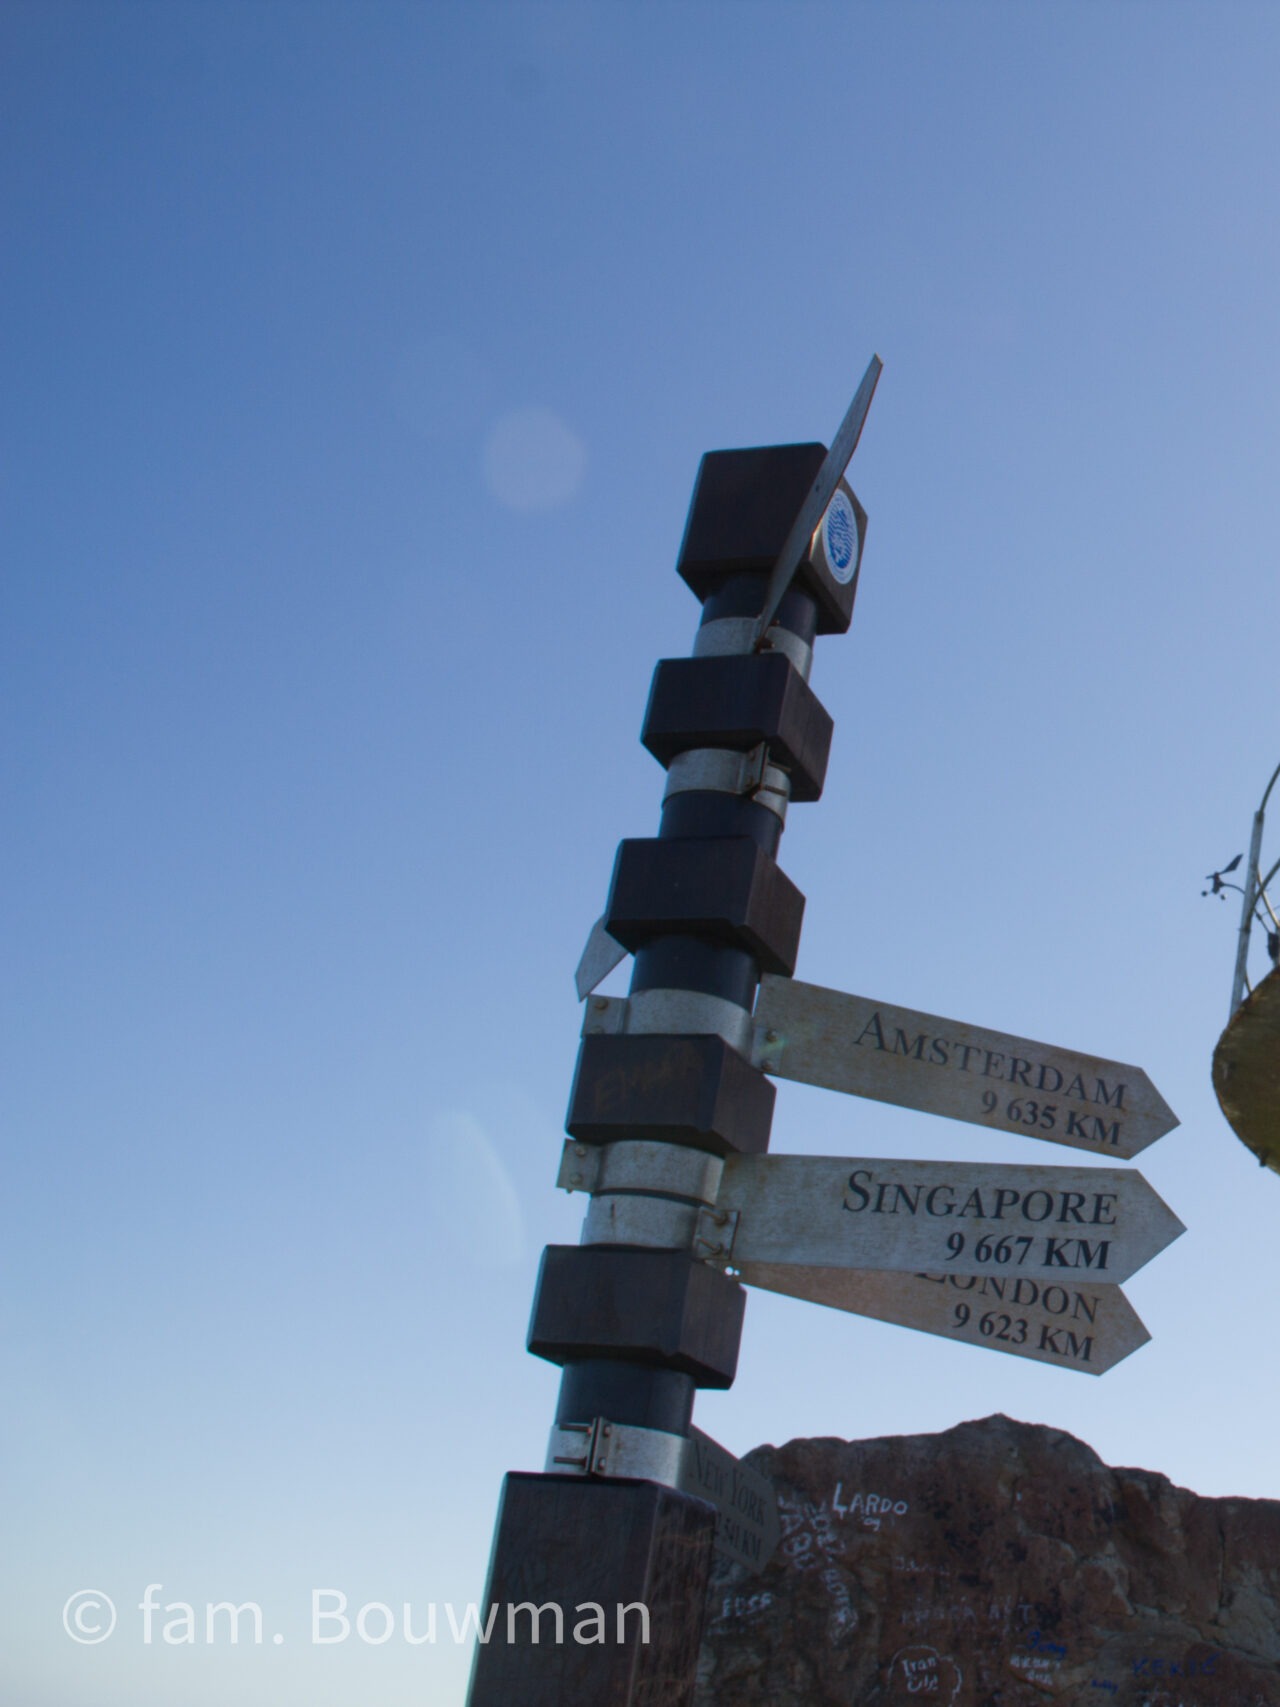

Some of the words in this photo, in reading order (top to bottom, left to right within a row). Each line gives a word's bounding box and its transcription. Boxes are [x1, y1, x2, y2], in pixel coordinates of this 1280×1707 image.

[853, 1011, 1129, 1110] AMSTERDAM
[981, 1090, 998, 1114] 9
[1007, 1094, 1056, 1130] 635
[1065, 1104, 1122, 1147] KM
[842, 1170, 1118, 1226] SINGAPORE
[945, 1231, 966, 1260] 9
[974, 1233, 1034, 1265] 667
[1042, 1238, 1111, 1270] KM
[952, 1302, 971, 1328] 9
[979, 1311, 1029, 1345] 623
[1036, 1323, 1095, 1362] KM
[728, 1465, 767, 1527] YORK
[832, 1481, 909, 1516] LARDO
